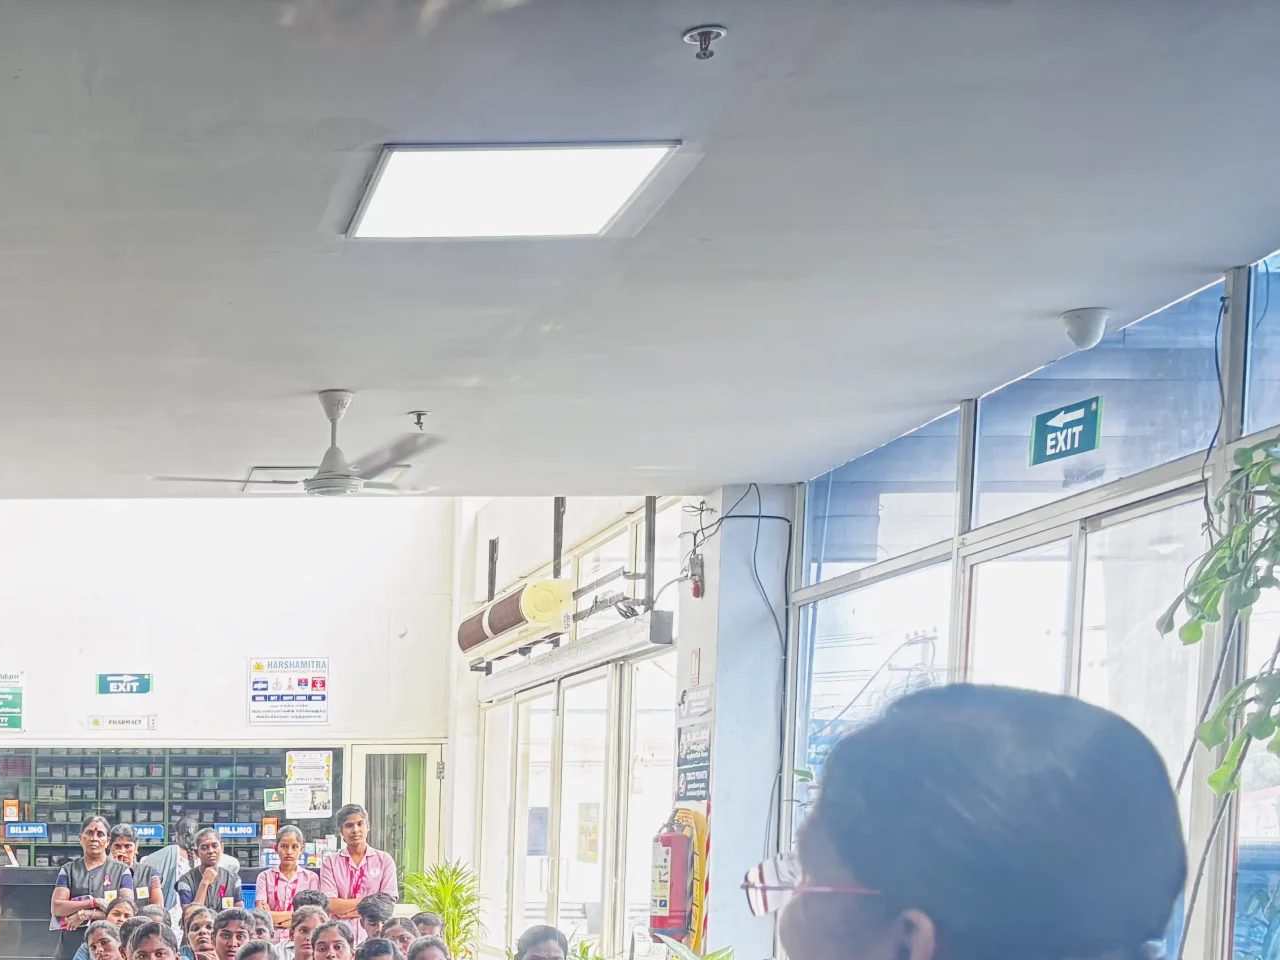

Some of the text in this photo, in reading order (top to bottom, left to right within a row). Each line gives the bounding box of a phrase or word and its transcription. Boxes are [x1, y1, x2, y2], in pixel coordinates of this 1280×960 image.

[1046, 425, 1083, 456] EXIT
[268, 660, 327, 669] HARSHAMITRA
[109, 682, 139, 692] EXIT
[9, 826, 43, 835] BILLING
[218, 826, 253, 835] BILLING
